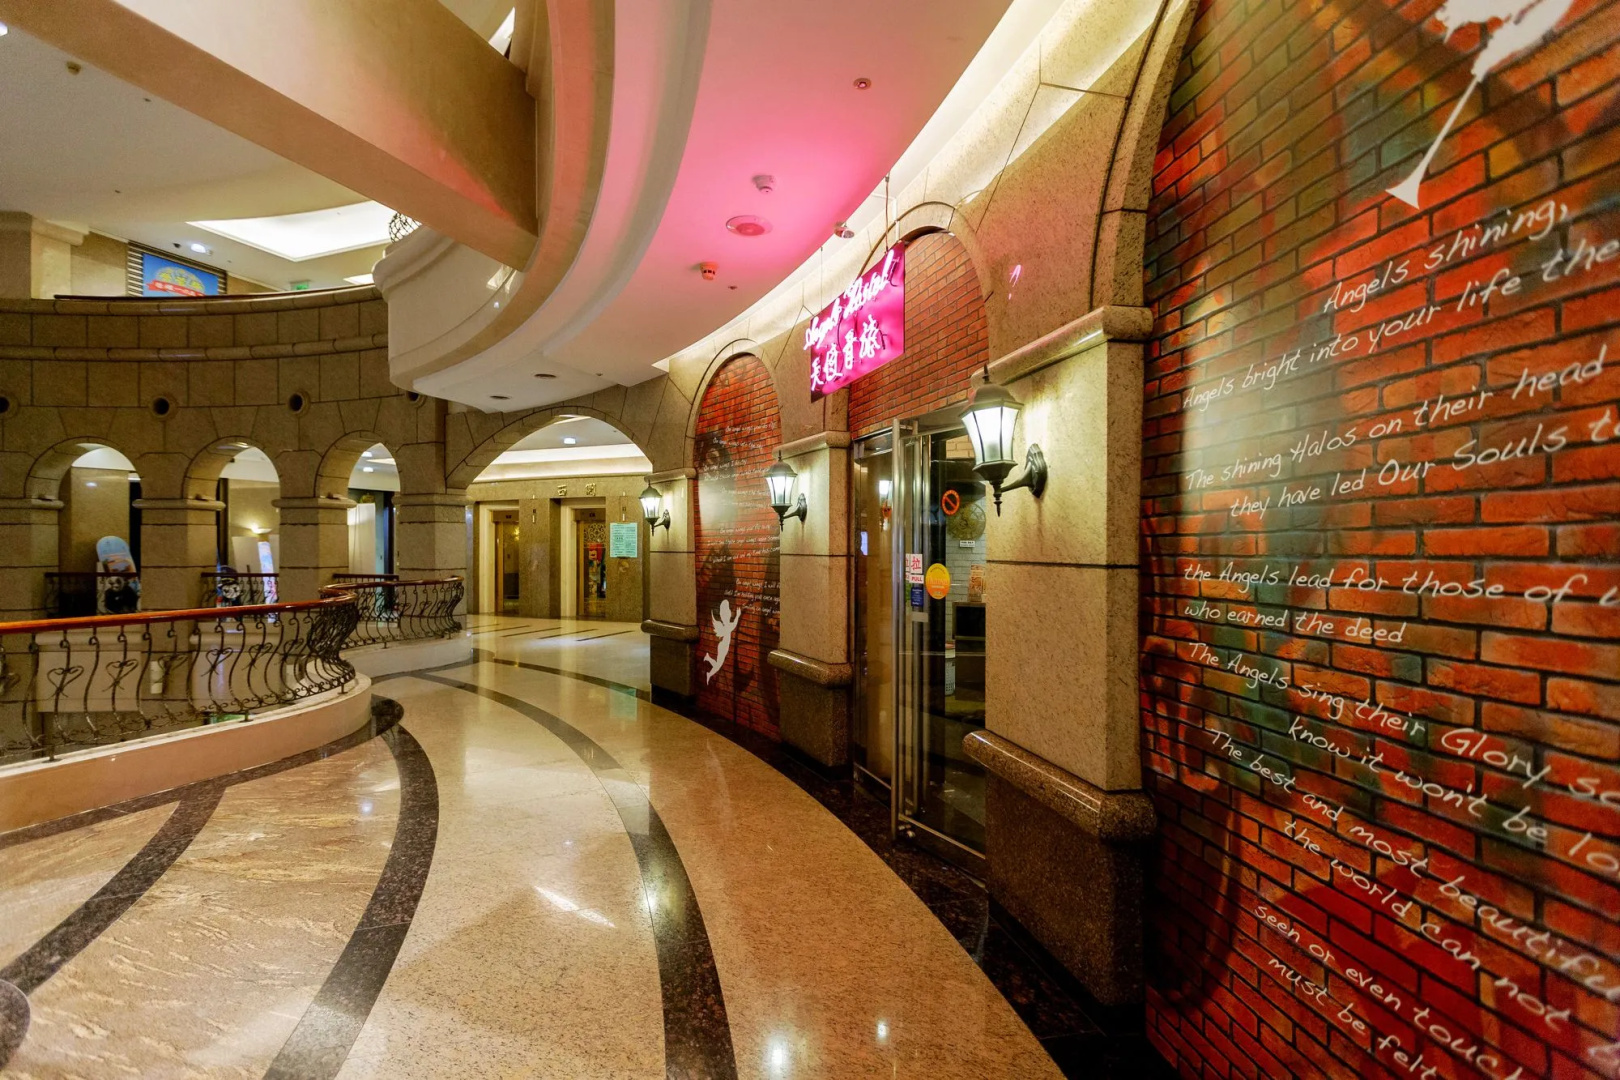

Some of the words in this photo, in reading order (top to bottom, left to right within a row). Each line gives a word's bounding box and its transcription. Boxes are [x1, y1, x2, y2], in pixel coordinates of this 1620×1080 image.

[1323, 262, 1409, 313] Angels
[1424, 200, 1569, 269] shining,
[1183, 376, 1235, 411] Angels
[1242, 352, 1302, 391] bright
[1309, 333, 1359, 363] into
[1368, 302, 1442, 353] your
[1457, 267, 1523, 313] life
[1185, 469, 1215, 492] The
[1220, 449, 1283, 486] shining
[1290, 426, 1357, 464] Halos
[1368, 418, 1404, 440] on
[1413, 390, 1494, 428] their
[1511, 342, 1609, 400] head
[1229, 493, 1269, 521] they
[1277, 485, 1322, 510] have
[1331, 470, 1365, 498] led
[1451, 422, 1569, 472] Souls
[1588, 409, 1620, 443] t
[1183, 564, 1213, 584] the
[1218, 562, 1282, 593] Angels
[1288, 564, 1332, 590] lead
[1341, 567, 1391, 593] for
[1400, 569, 1506, 601] those
[1523, 573, 1589, 604] of
[1183, 600, 1222, 621] who
[1226, 607, 1289, 628] earned
[1294, 610, 1335, 637] the
[1345, 620, 1408, 645] deed
[1187, 641, 1221, 669] The
[1227, 655, 1291, 692] Angels
[1298, 681, 1346, 721] sing
[1354, 697, 1428, 738] their
[1439, 727, 1553, 791] Glory
[1206, 728, 1244, 762] The
[1249, 753, 1298, 794] best
[1302, 791, 1345, 822] and
[1349, 823, 1430, 879] most
[1286, 715, 1353, 760] know
[1358, 744, 1386, 774] it
[1395, 769, 1490, 818] won't
[1501, 805, 1550, 845] be
[1568, 831, 1620, 880] lo
[1284, 819, 1322, 857] the
[1329, 858, 1414, 919] world
[1420, 920, 1483, 972] can
[1493, 976, 1572, 1033] not
[1308, 942, 1337, 964] or
[1345, 966, 1403, 1013] even
[1267, 957, 1331, 1008] must
[1336, 1003, 1368, 1037] be
